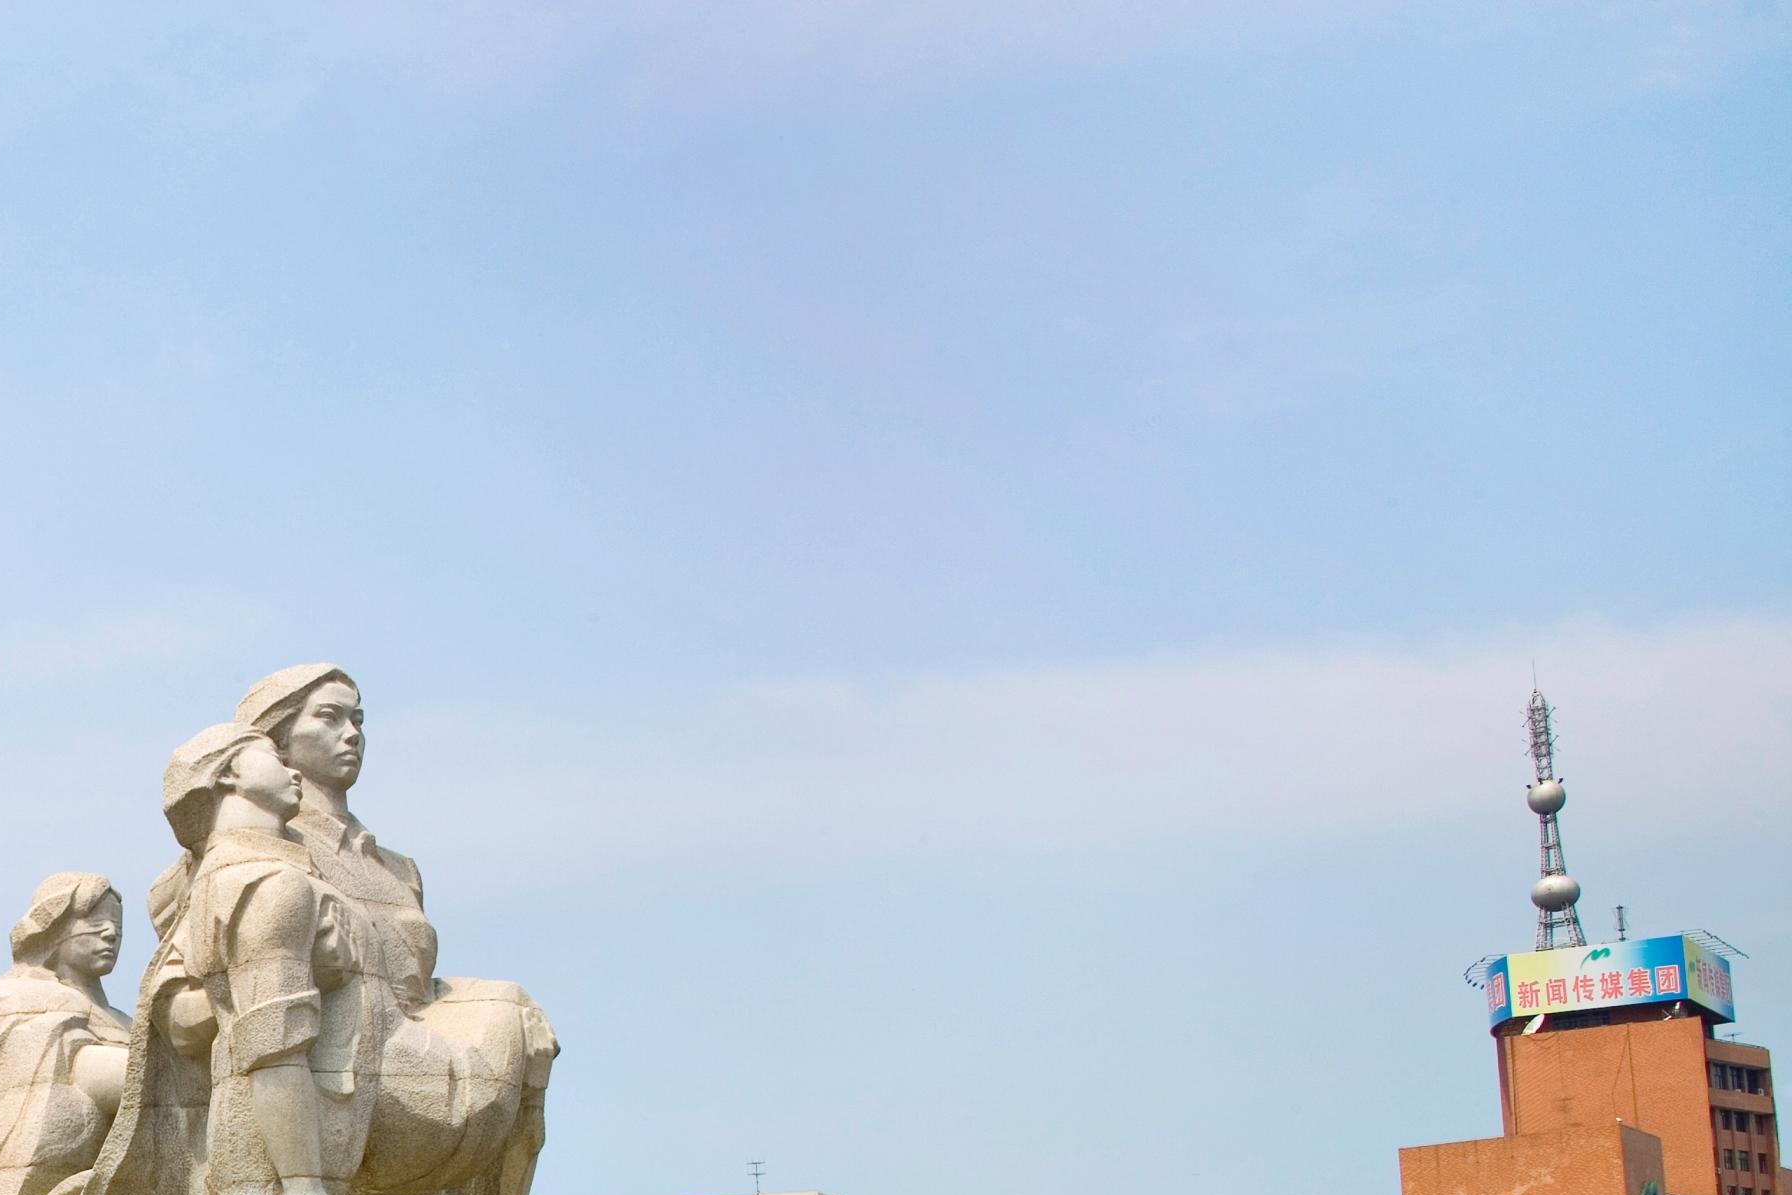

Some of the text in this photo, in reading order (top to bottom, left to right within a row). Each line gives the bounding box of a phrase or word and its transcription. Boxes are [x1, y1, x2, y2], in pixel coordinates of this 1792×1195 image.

[1517, 965, 1681, 1009] 新闻传媒集团
